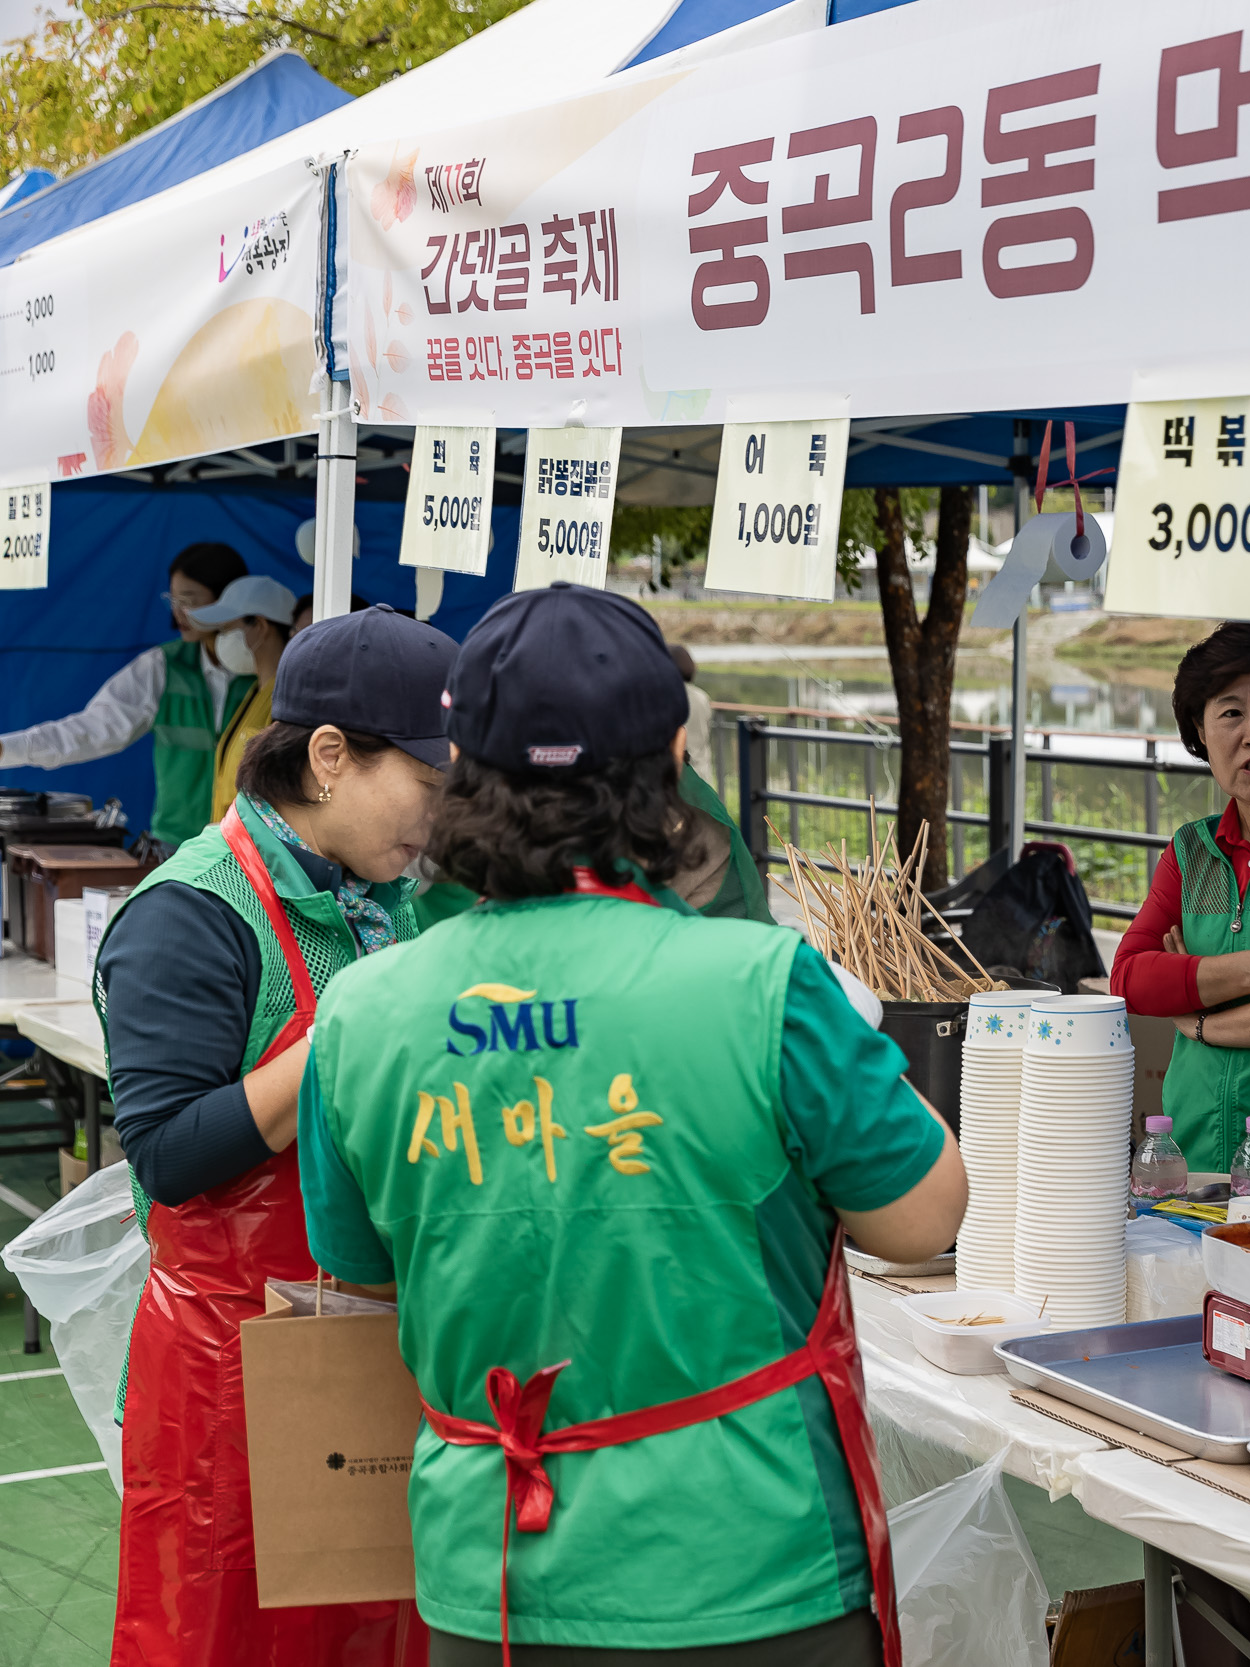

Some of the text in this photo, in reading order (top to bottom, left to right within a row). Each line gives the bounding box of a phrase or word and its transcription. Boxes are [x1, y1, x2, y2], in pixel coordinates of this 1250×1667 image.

[424, 157, 486, 213] 제11회
[688, 63, 1102, 331] 중곡2동
[421, 207, 619, 315] 간뎃골 축제
[26, 294, 54, 327] 3,000
[28, 350, 55, 382] 1,000
[427, 327, 622, 381] 꿈을 잇다, 중곡을 잇다
[422, 494, 483, 532] 5,000원
[537, 517, 603, 559] 5,000원
[738, 502, 821, 548] 1,000원
[446, 998, 579, 1057] SMU
[407, 1073, 664, 1186] 새마을
